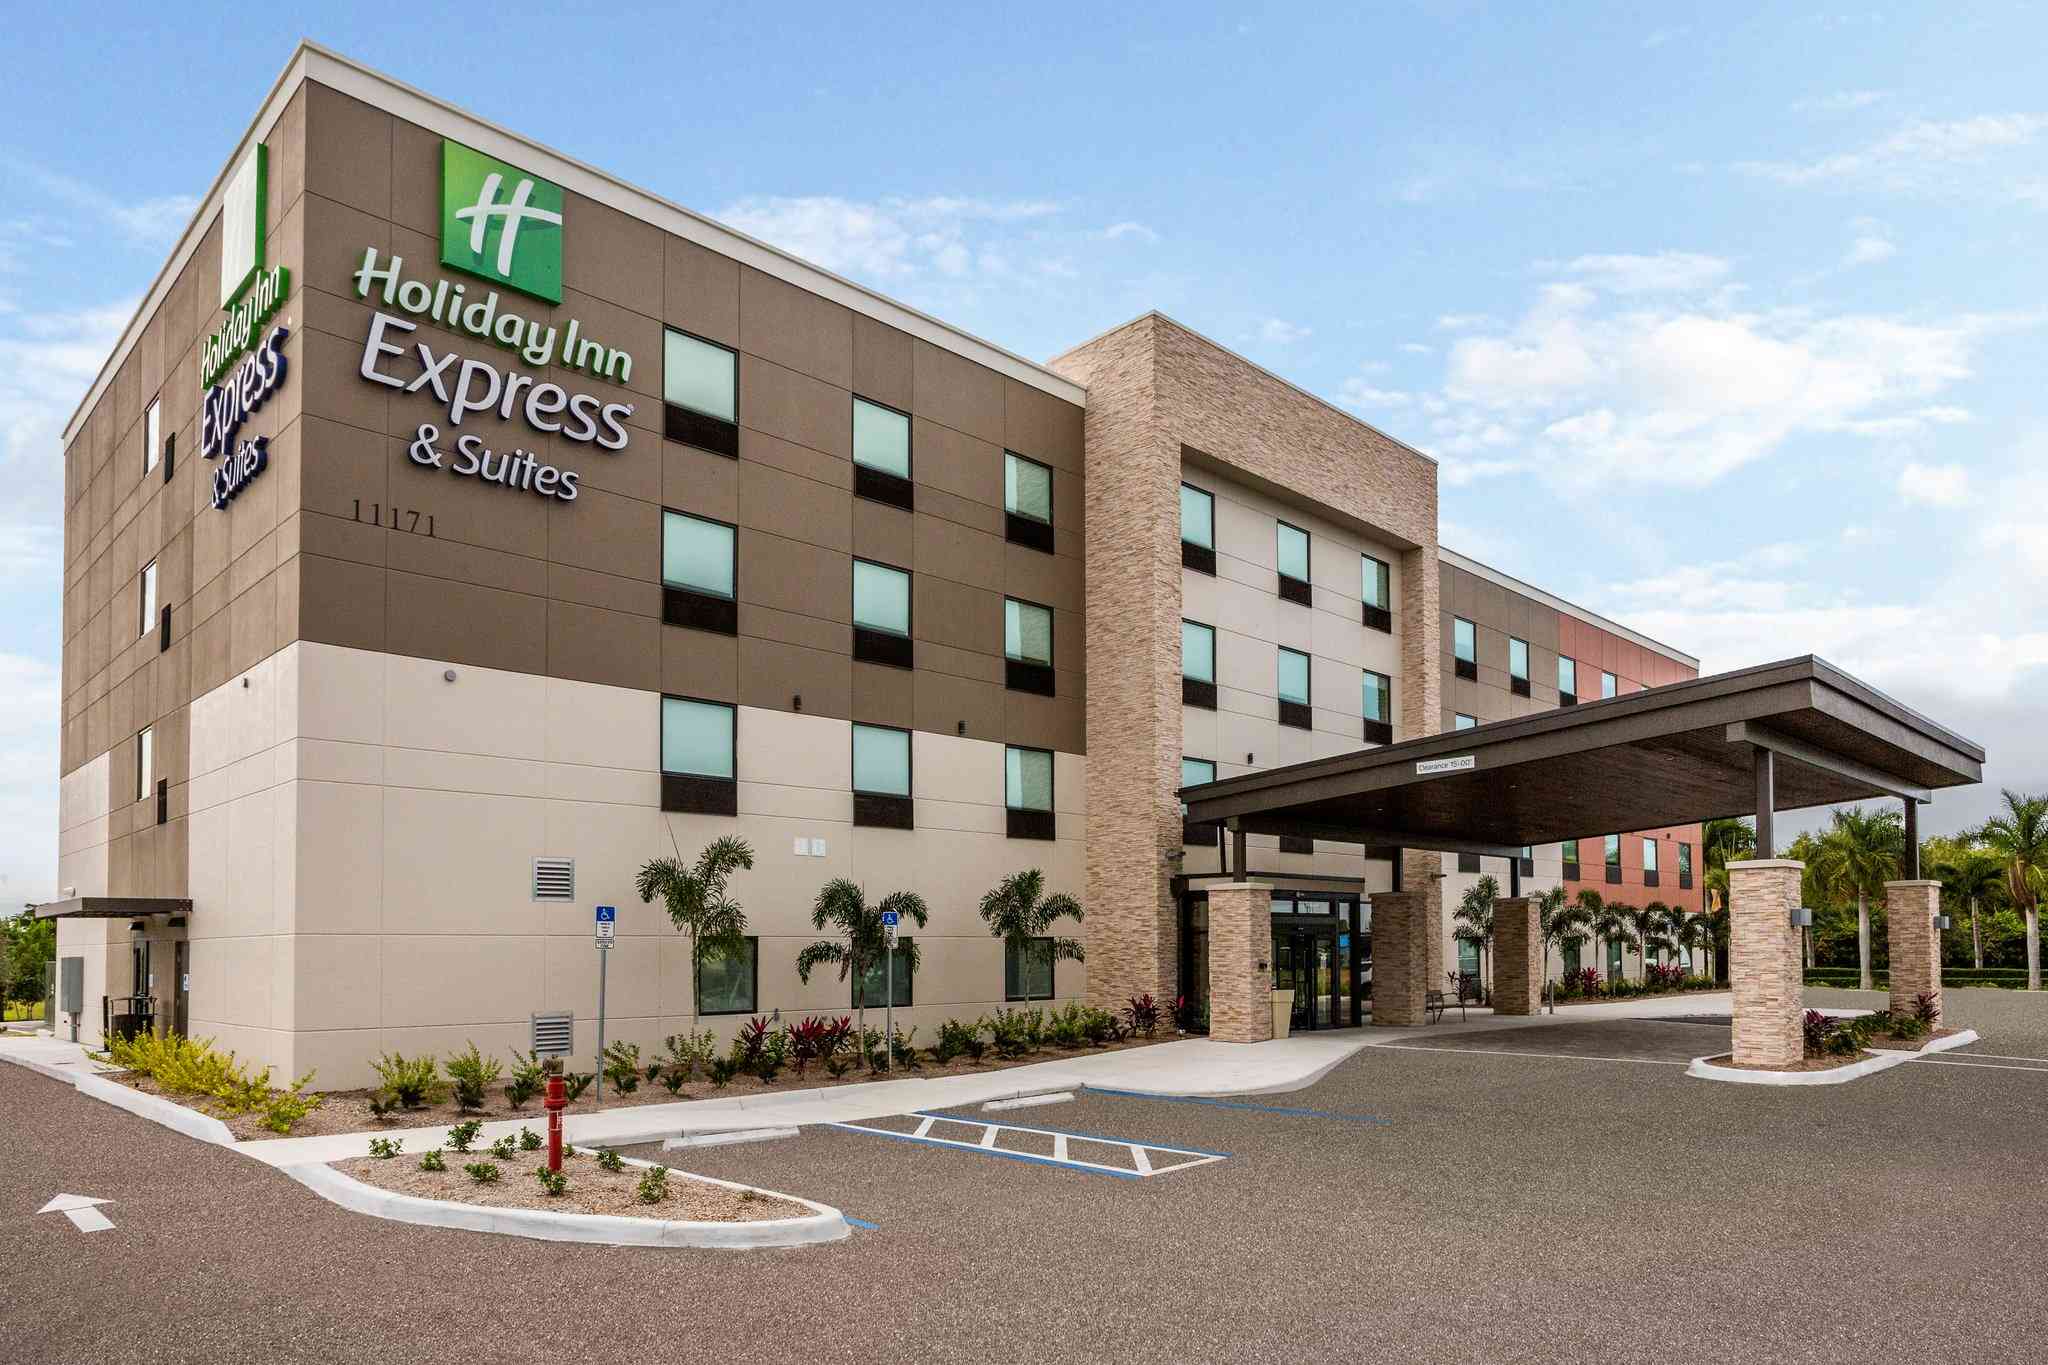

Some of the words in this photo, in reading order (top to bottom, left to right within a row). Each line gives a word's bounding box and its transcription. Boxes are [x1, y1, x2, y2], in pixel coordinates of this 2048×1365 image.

[200, 301, 252, 389] Holiday
[253, 265, 286, 325] Inn
[353, 246, 556, 366] Holiday
[562, 319, 633, 383] Inn
[200, 328, 287, 458] Express
[360, 311, 632, 453] Express
[210, 466, 225, 511] &
[220, 434, 268, 500] Suites
[353, 499, 435, 538] 11171
[408, 423, 442, 469] &
[452, 434, 580, 501] Suites
